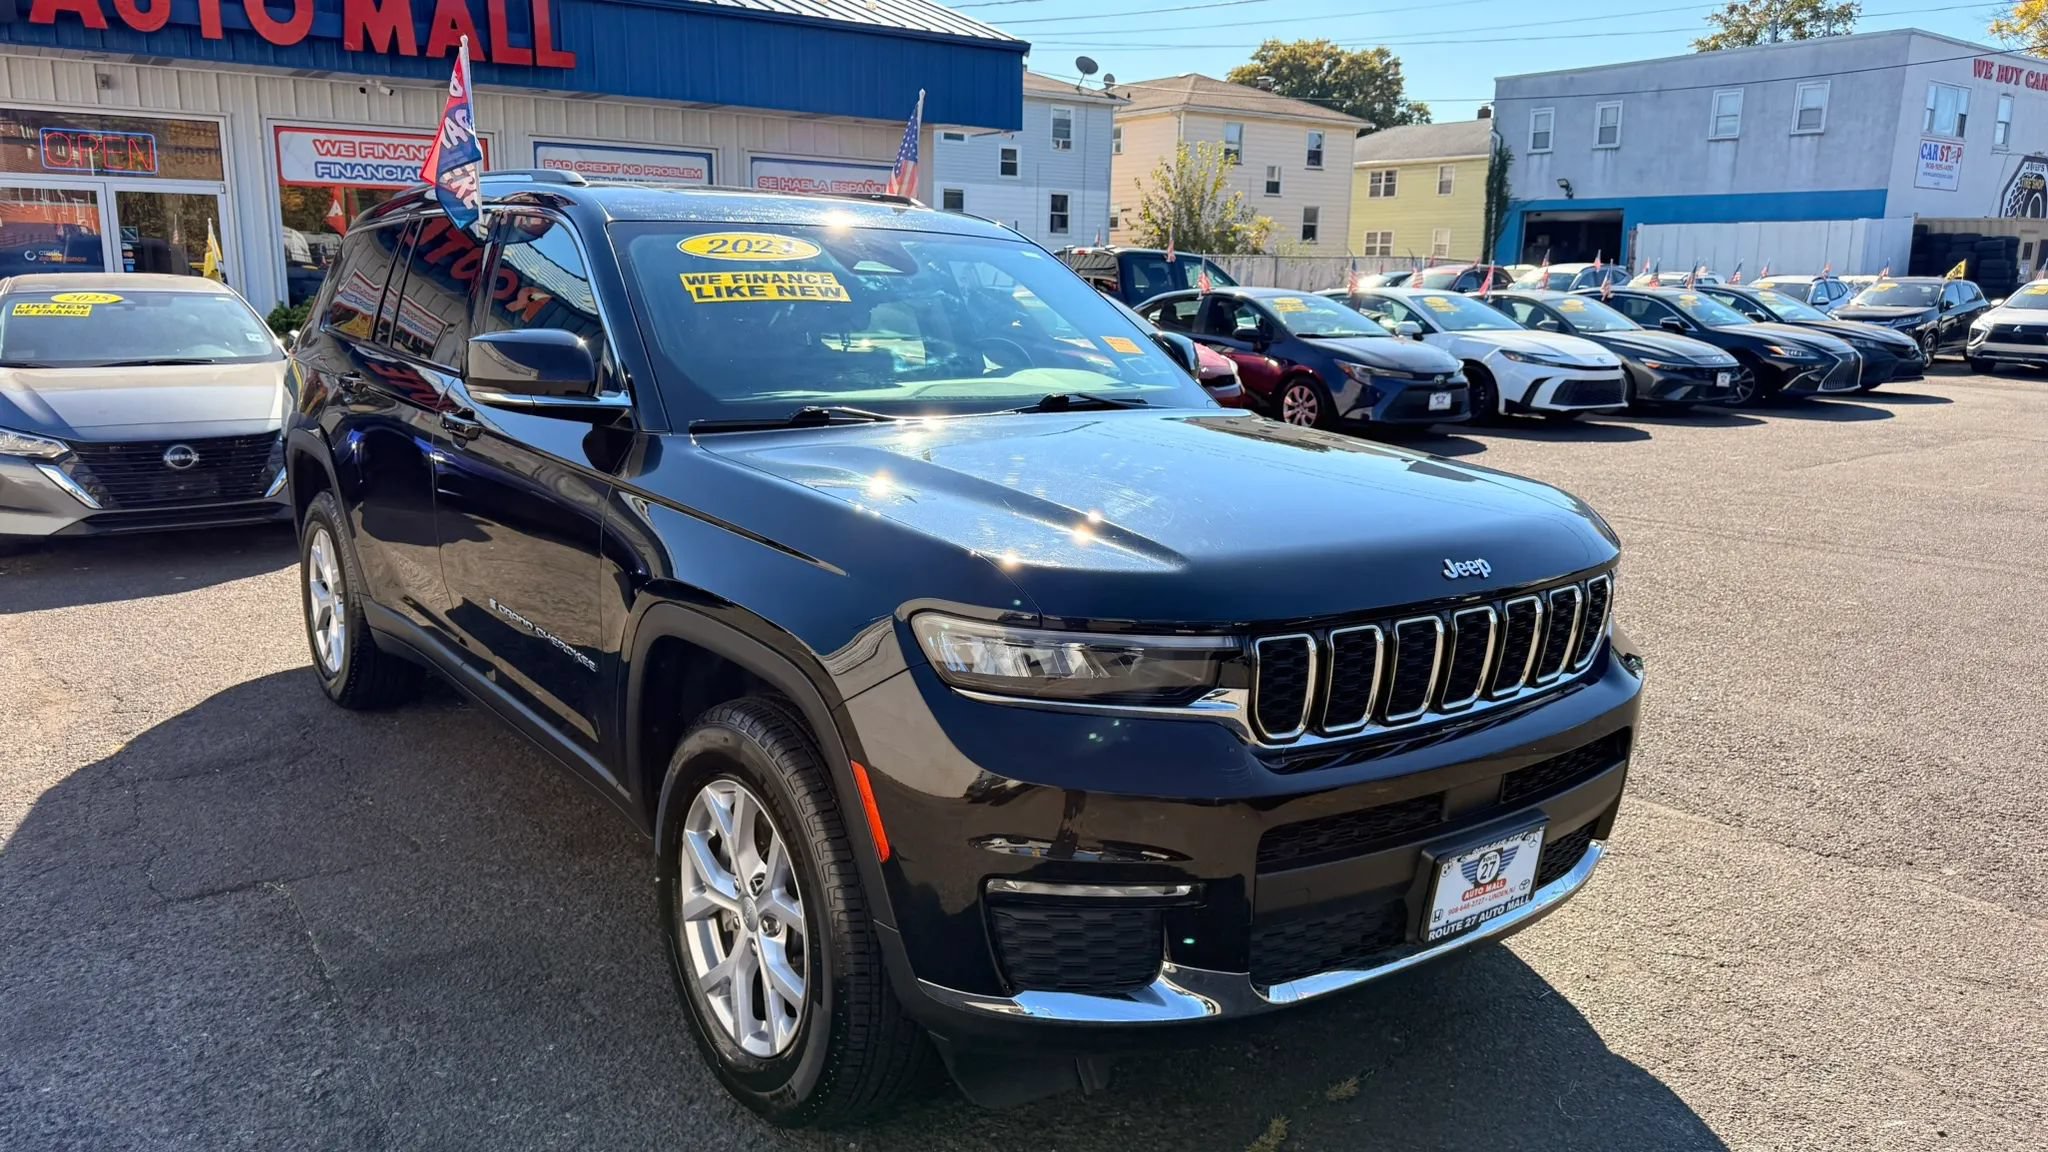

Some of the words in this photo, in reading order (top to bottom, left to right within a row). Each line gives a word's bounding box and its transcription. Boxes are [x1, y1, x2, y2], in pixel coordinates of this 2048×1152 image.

[343, 0, 576, 69] MALL
[1974, 58, 1994, 80] WE
[1996, 65, 2025, 86] BUY
[45, 132, 154, 170] OPEN
[313, 139, 354, 157] WE
[1921, 143, 1939, 161] CAR
[544, 159, 572, 170] BAD
[575, 161, 621, 174] CREDIT
[622, 163, 642, 175] NO
[644, 165, 703, 179] PROBLEM
[758, 176, 778, 190] SE
[780, 177, 828, 192] HABLA
[685, 274, 721, 286] WE
[731, 273, 833, 285] FINANCE
[696, 285, 767, 299] LIKE
[776, 285, 841, 298] NEW
[163, 453, 200, 463] NISSAN
[1443, 558, 1492, 579] Jeep
[498, 604, 534, 631] GRAND
[1480, 860, 1496, 880] 27
[1463, 888, 1484, 900] AUTO
[1485, 880, 1504, 893] MALL
[1428, 921, 1463, 941] ROUTE
[1464, 915, 1477, 928] 27
[1479, 905, 1504, 922] AUTO
[1506, 895, 1530, 910] MALL
